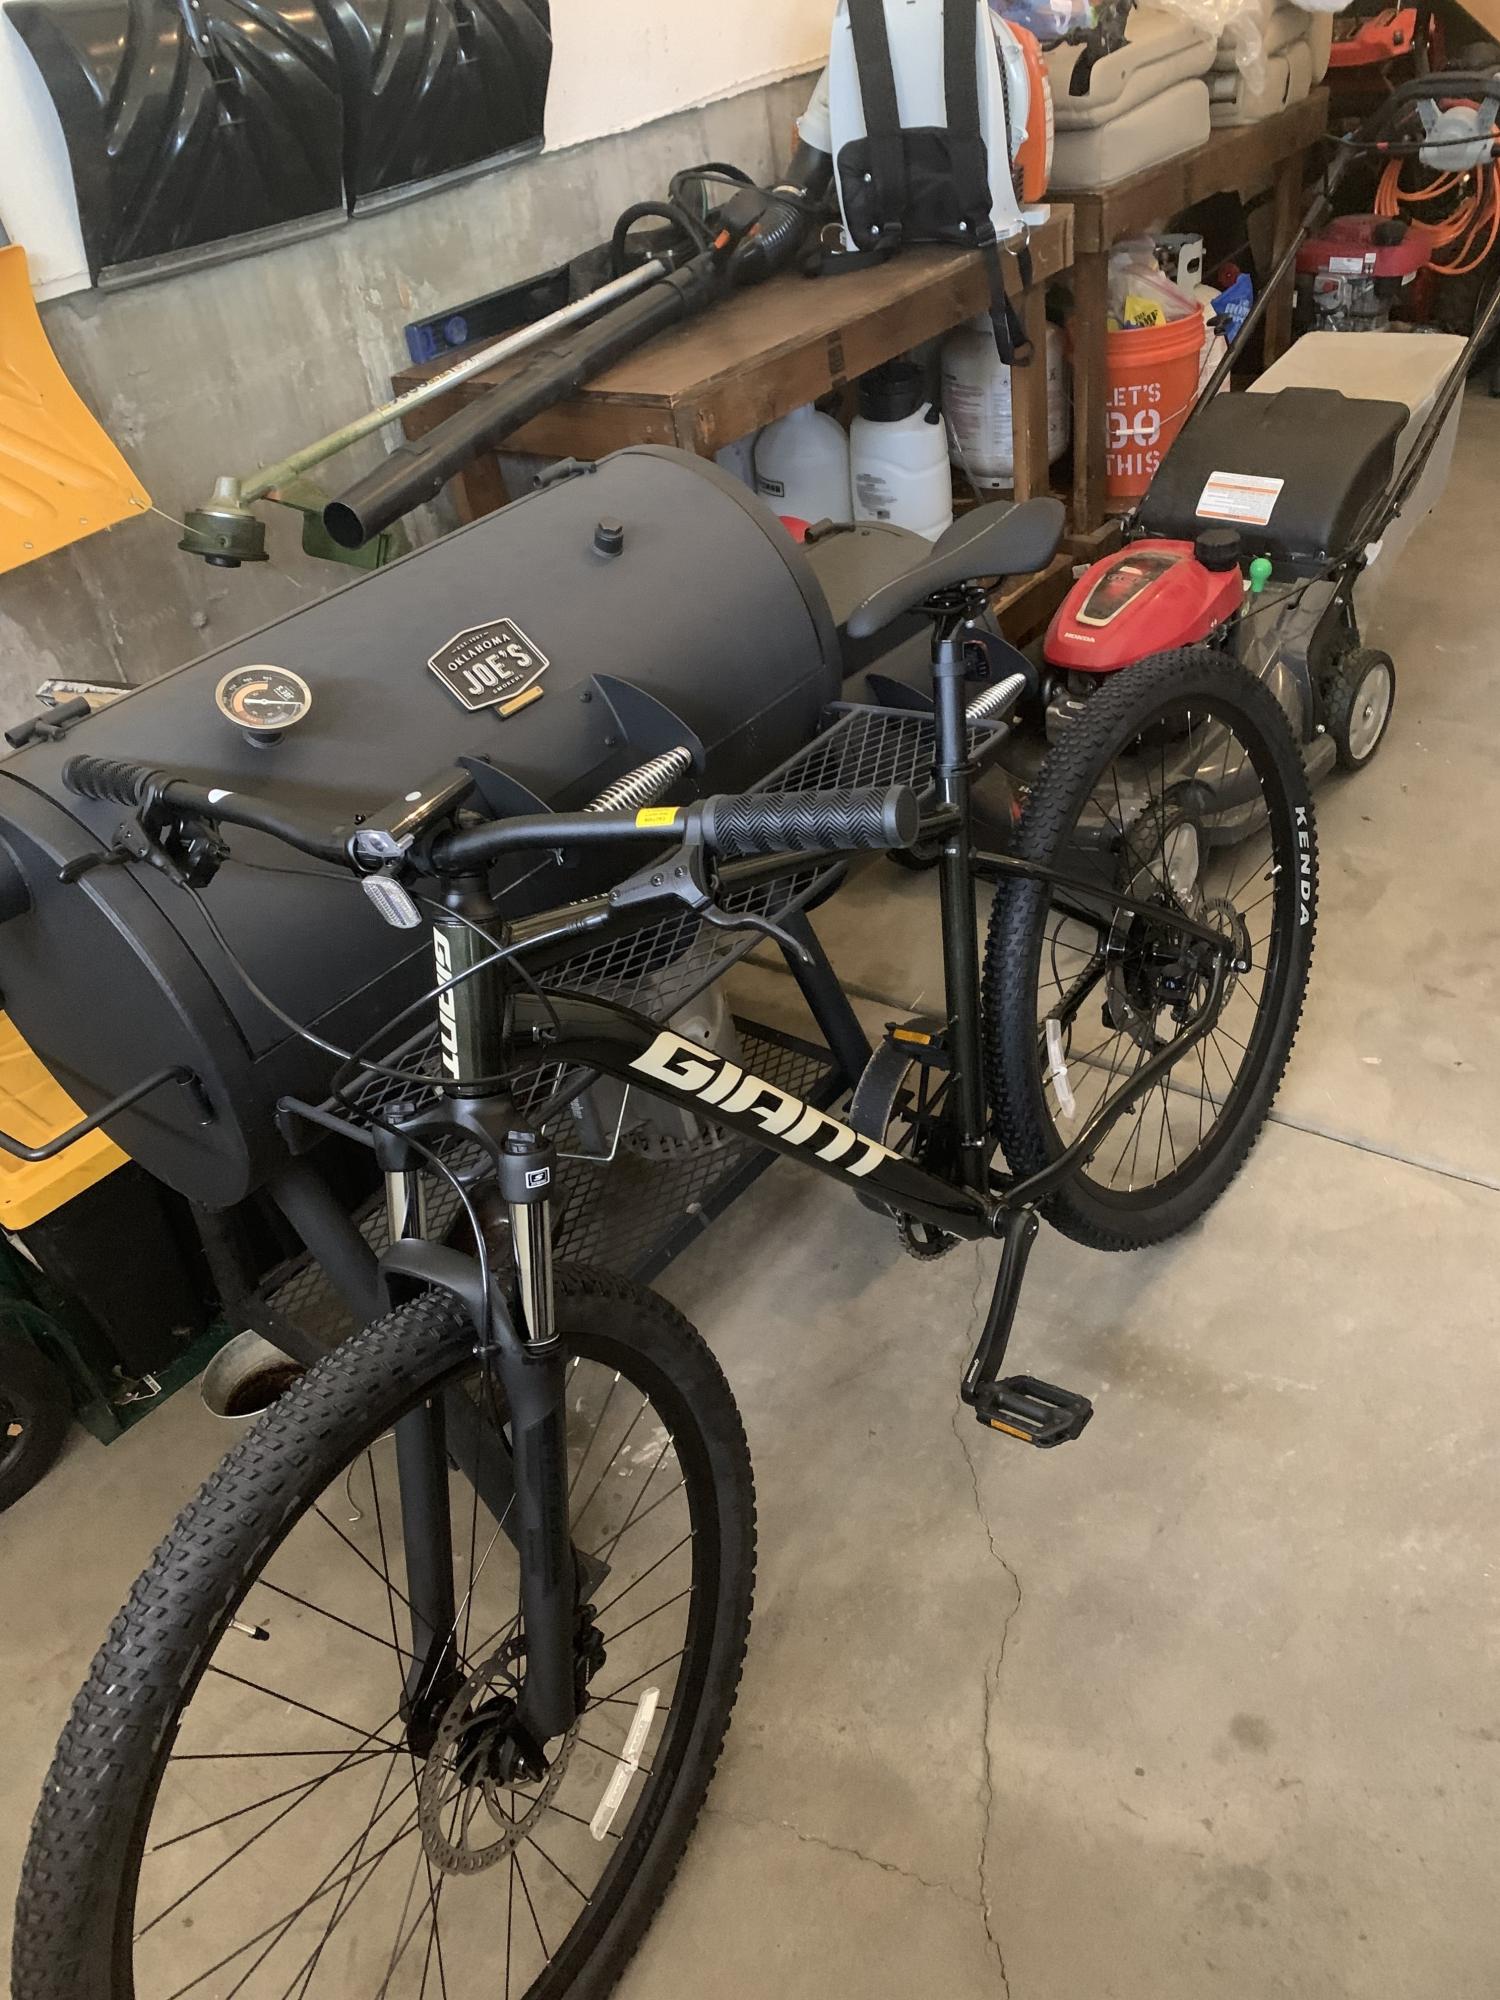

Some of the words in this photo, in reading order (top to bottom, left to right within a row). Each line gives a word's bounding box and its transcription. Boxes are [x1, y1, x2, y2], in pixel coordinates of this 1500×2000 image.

[1106, 408, 1161, 449] DO
[1106, 450, 1160, 477] THIS
[448, 633, 511, 671] OKLAHOMA
[1064, 632, 1096, 643] HONDA
[463, 643, 533, 696] JOE'S
[1294, 806, 1311, 926] KENDA
[432, 926, 460, 1080] GIANT
[628, 1031, 903, 1178] GIANT
